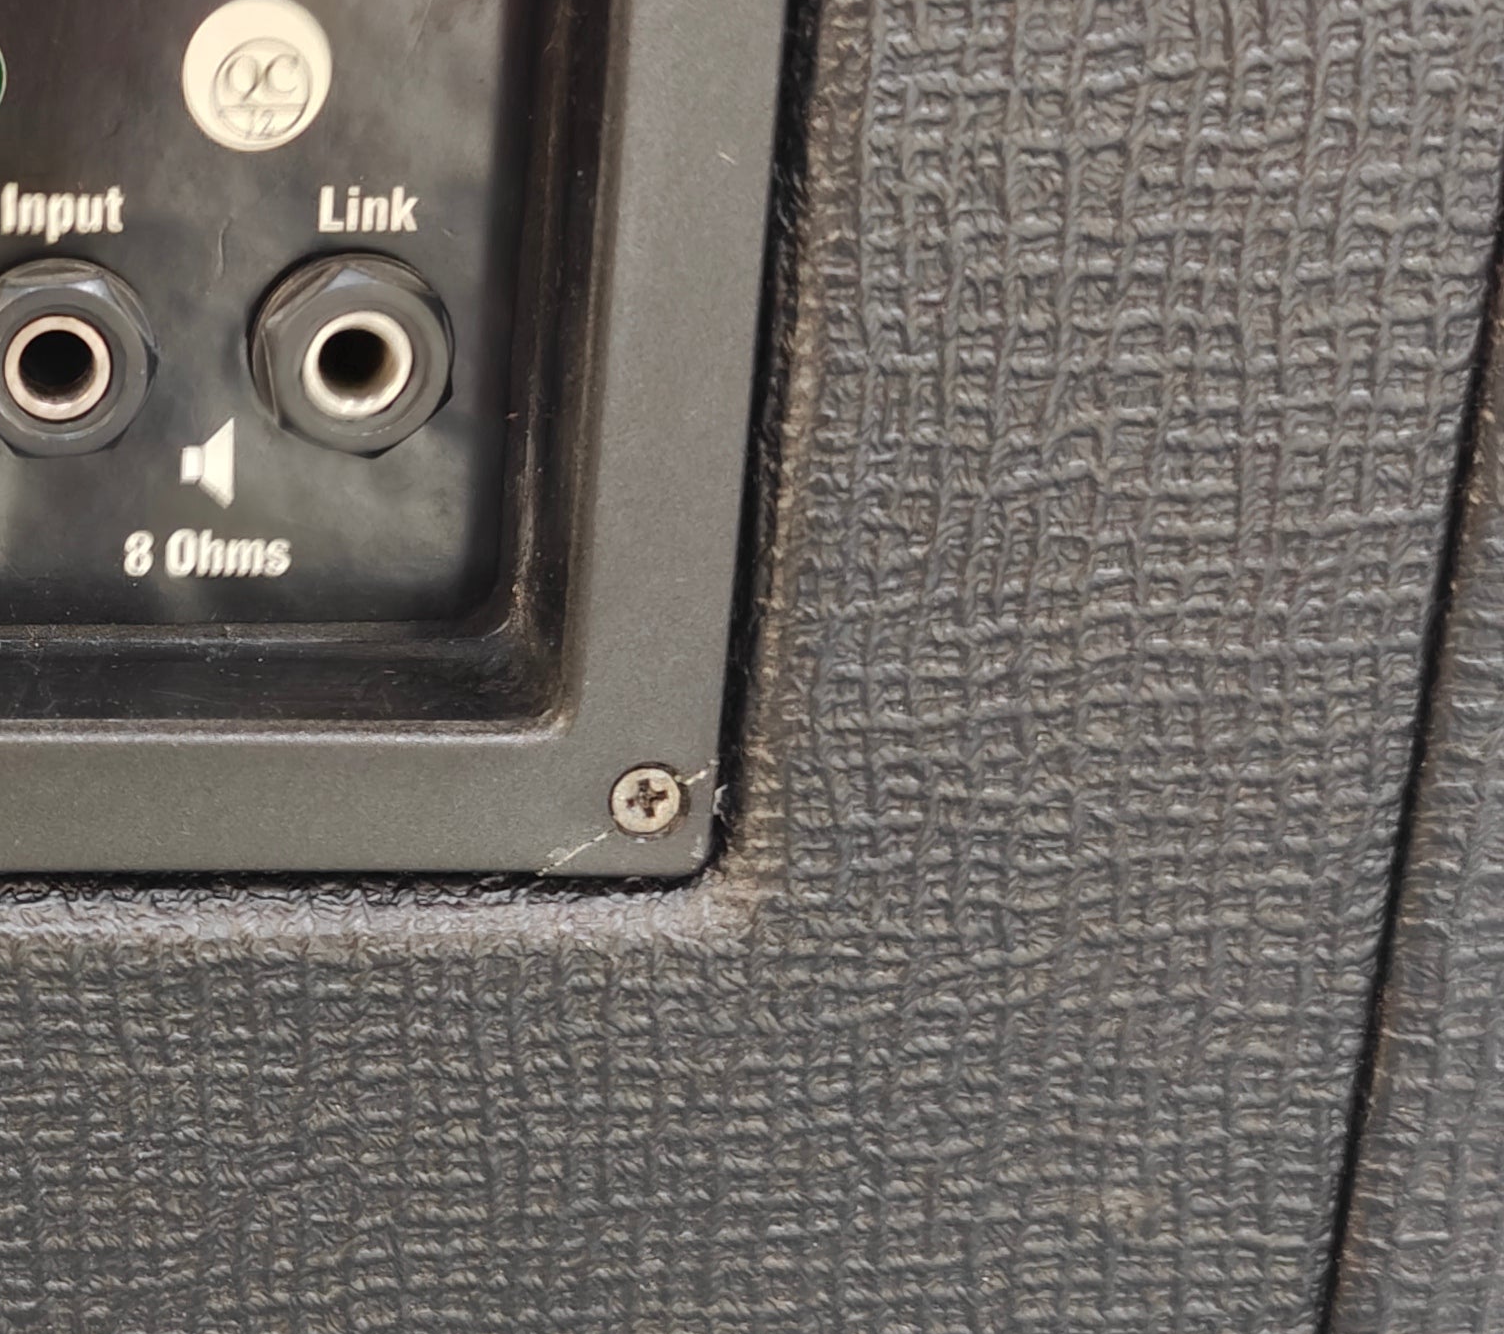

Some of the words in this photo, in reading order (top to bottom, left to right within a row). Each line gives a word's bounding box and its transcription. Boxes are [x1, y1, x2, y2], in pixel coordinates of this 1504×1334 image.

[224, 54, 300, 101] QC
[0, 183, 125, 244] Input
[318, 186, 420, 234] Link
[124, 532, 154, 576] 8
[165, 529, 291, 577] Ohms
